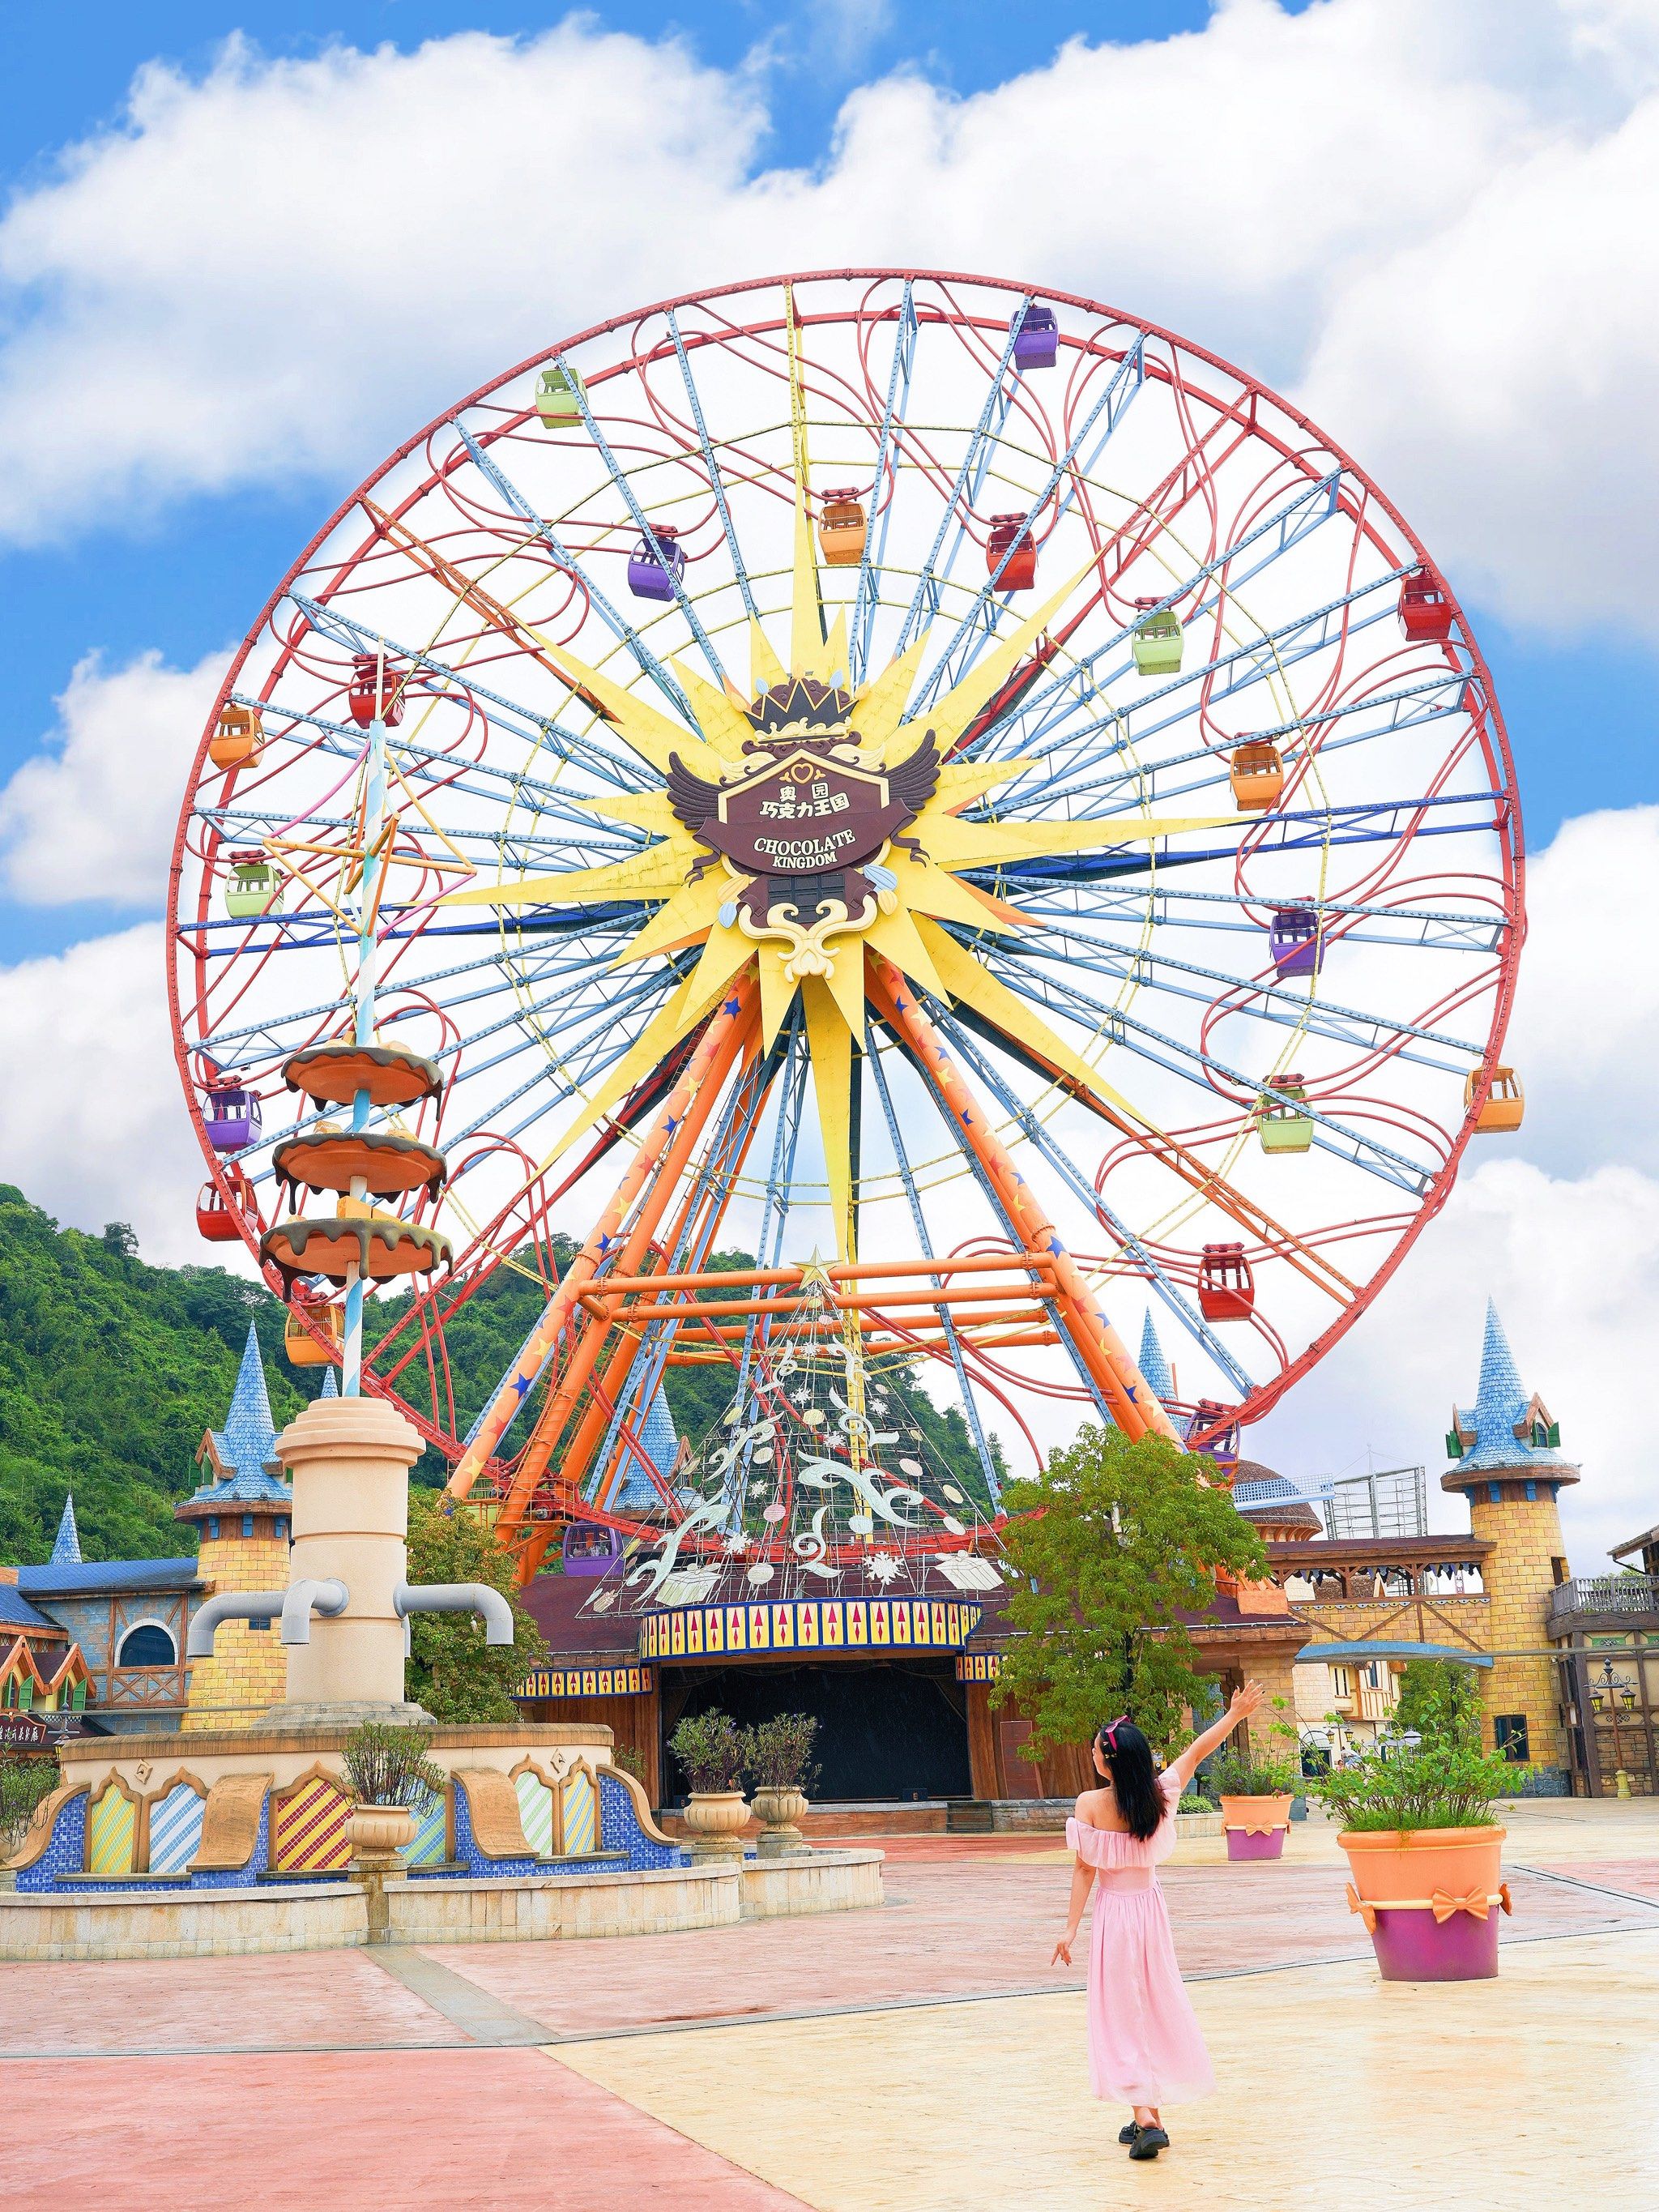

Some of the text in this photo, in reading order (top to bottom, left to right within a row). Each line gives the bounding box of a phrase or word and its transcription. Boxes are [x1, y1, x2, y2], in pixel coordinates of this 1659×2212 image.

[759, 792, 851, 819] 巧克力王国
[753, 828, 856, 856] CHOCOLATE
[772, 851, 838, 869] KINGDOM
